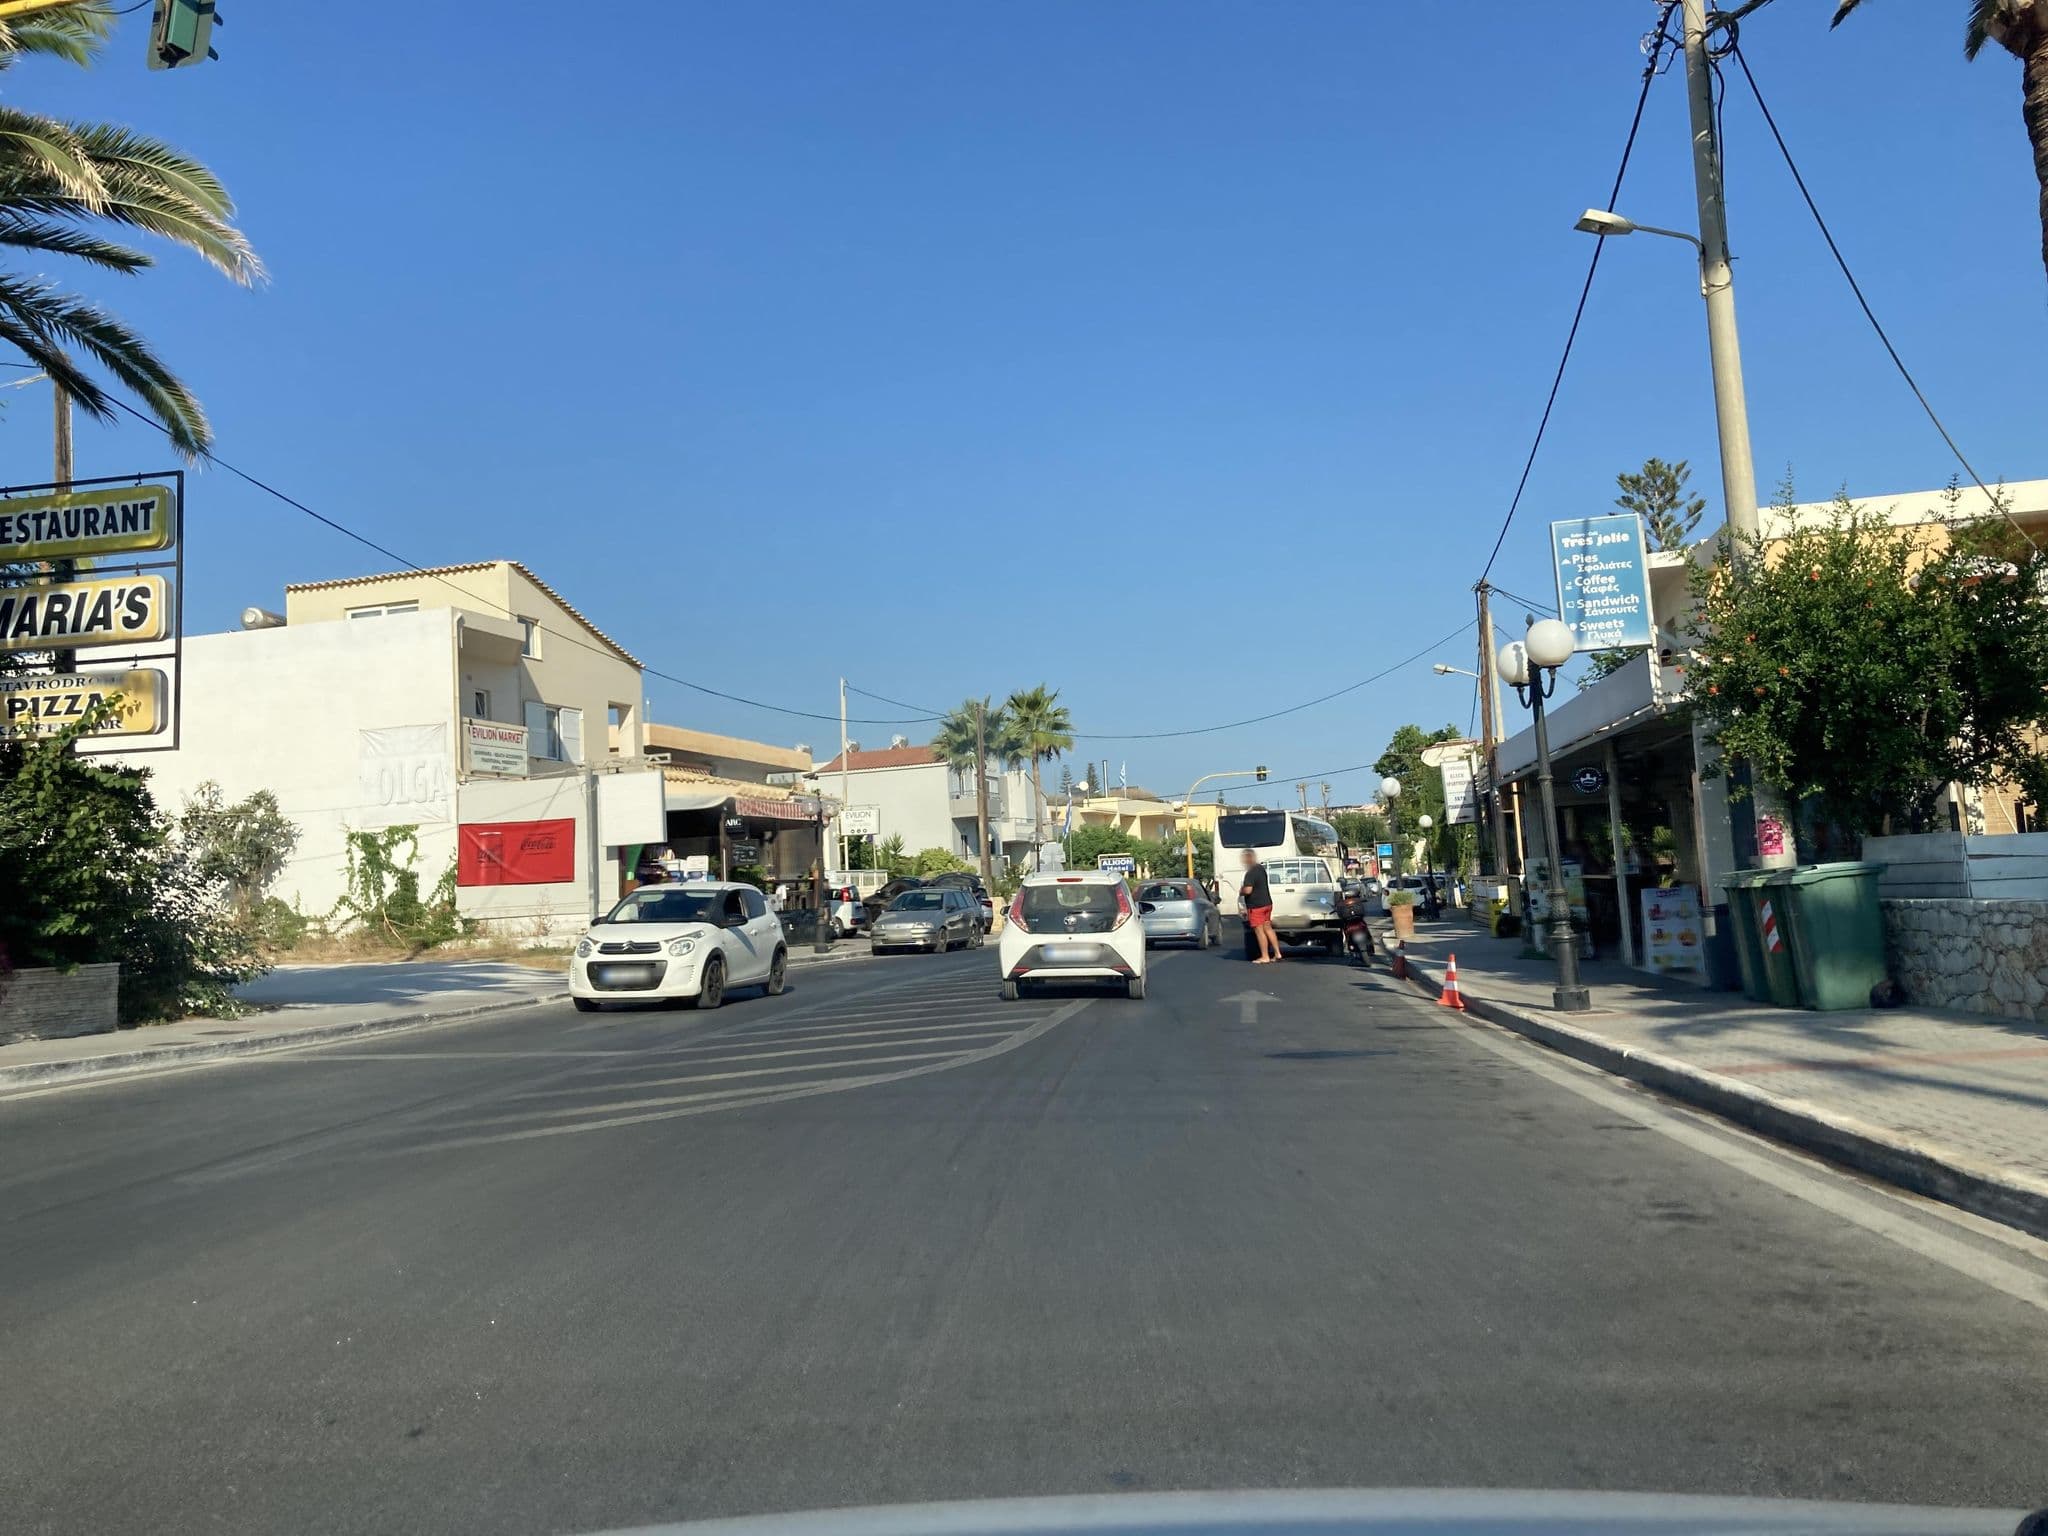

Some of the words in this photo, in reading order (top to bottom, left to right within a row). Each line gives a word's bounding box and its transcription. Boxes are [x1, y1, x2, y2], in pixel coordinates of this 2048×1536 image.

[1572, 554, 1598, 564] Pies
[1577, 560, 1632, 573] Σφολιάτες
[1574, 575, 1616, 586] Coffee
[1583, 584, 1620, 594] Καφές
[1577, 594, 1640, 608] Sandwich
[1580, 619, 1624, 631] Sweets
[1587, 629, 1622, 640] Γλυκά
[7, 692, 107, 719] PIZZA
[472, 727, 497, 741] EVILION
[499, 731, 523, 744] MARKET
